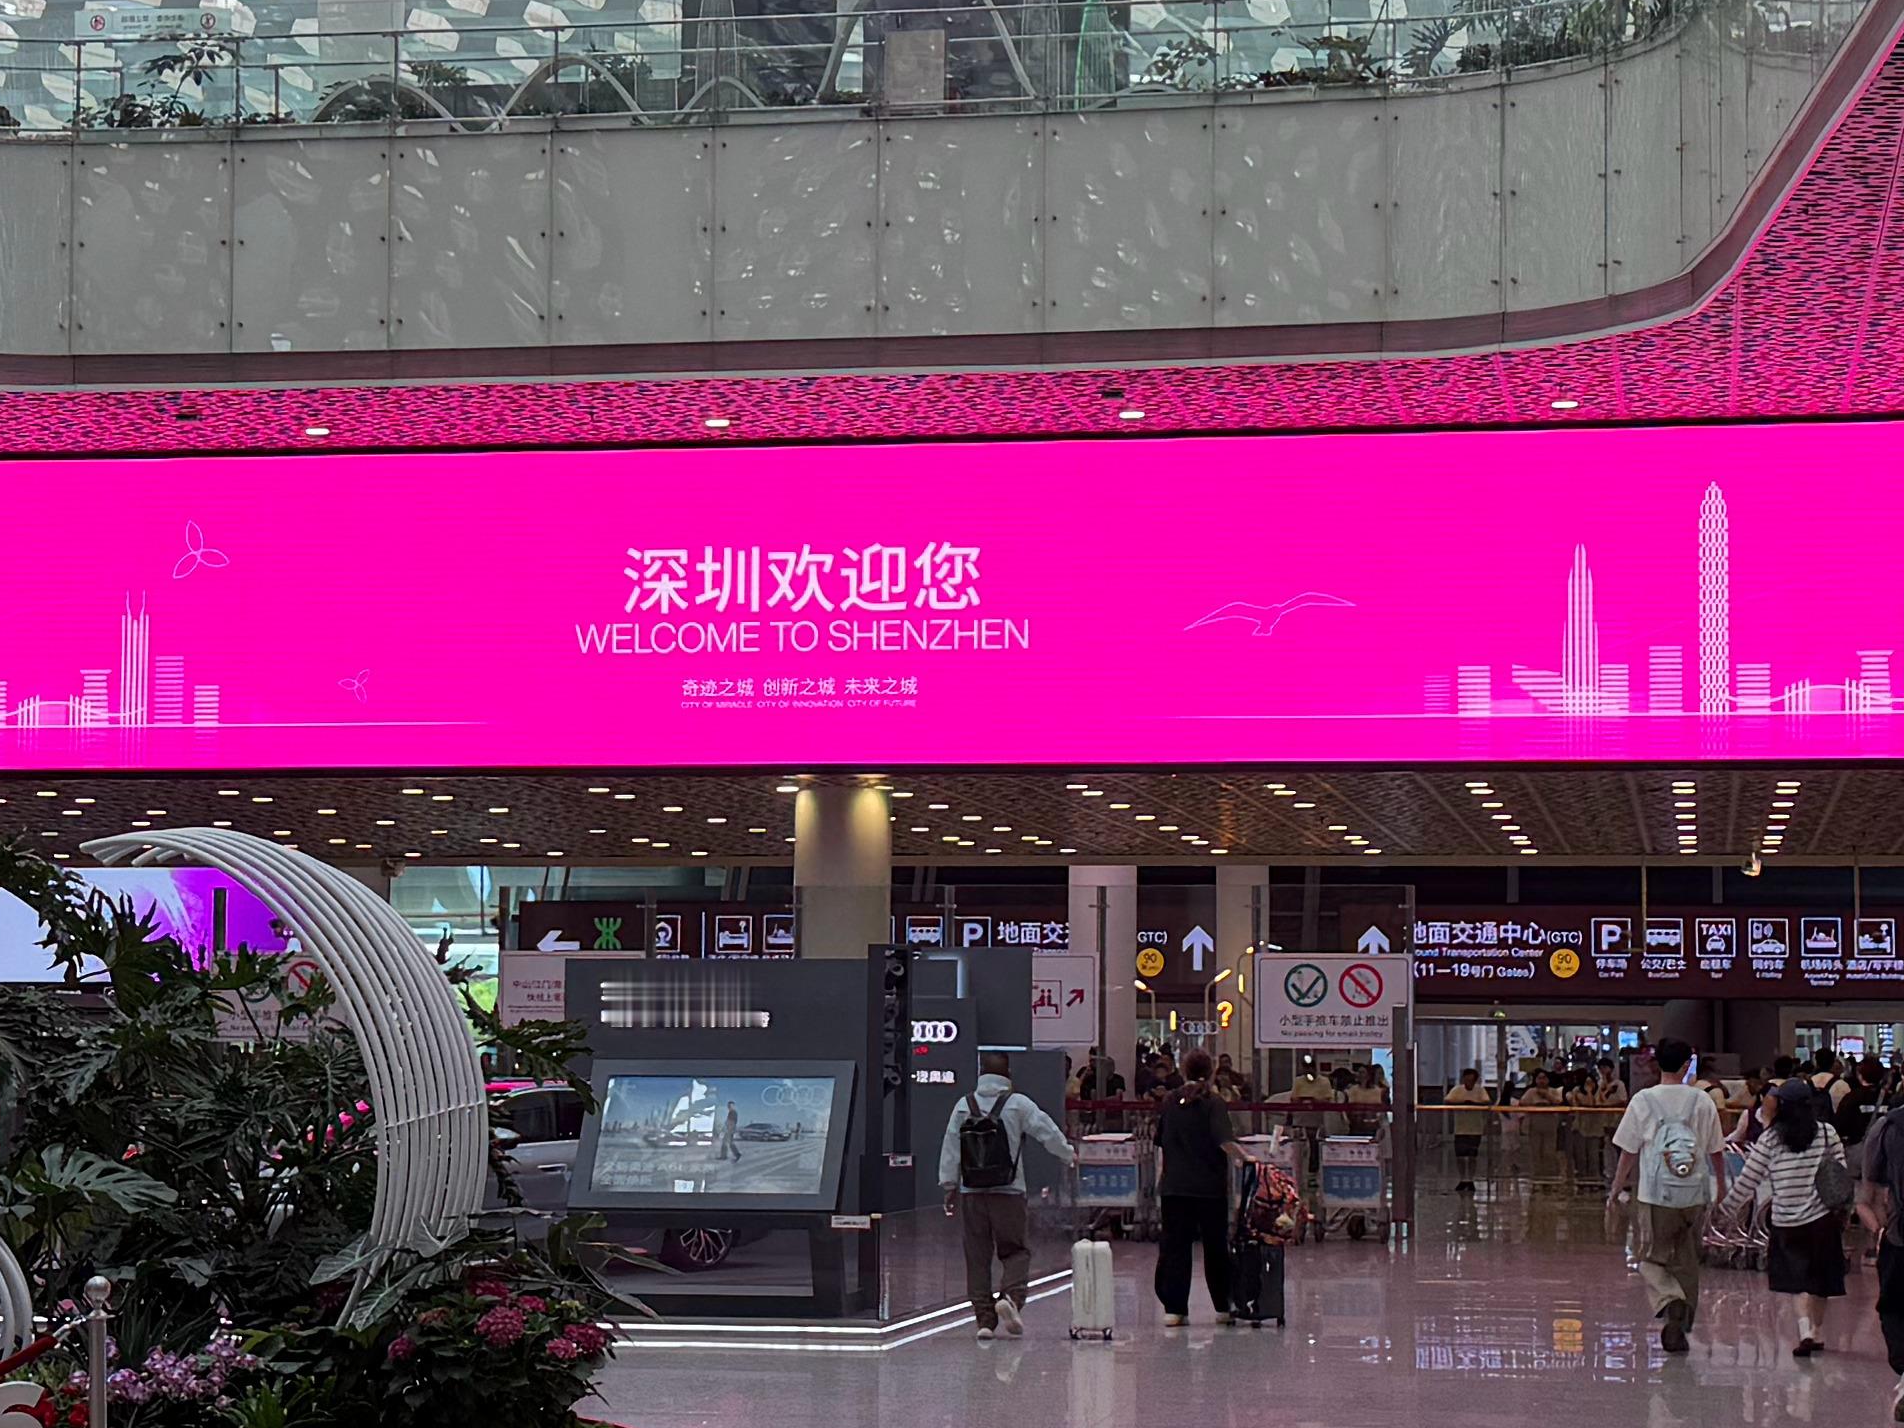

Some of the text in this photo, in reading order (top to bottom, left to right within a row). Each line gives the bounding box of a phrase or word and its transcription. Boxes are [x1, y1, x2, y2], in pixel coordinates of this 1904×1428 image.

[623, 541, 981, 615] 深圳欢迎您
[575, 618, 1031, 655] WELCOME TO SHENZHEN
[682, 676, 918, 698] 奇迹之城 创新之城 未来之城
[997, 920, 1069, 945] 地面交
[1700, 923, 1732, 936] TAXI
[1414, 948, 1439, 958] ound
[1557, 954, 1572, 964] 90
